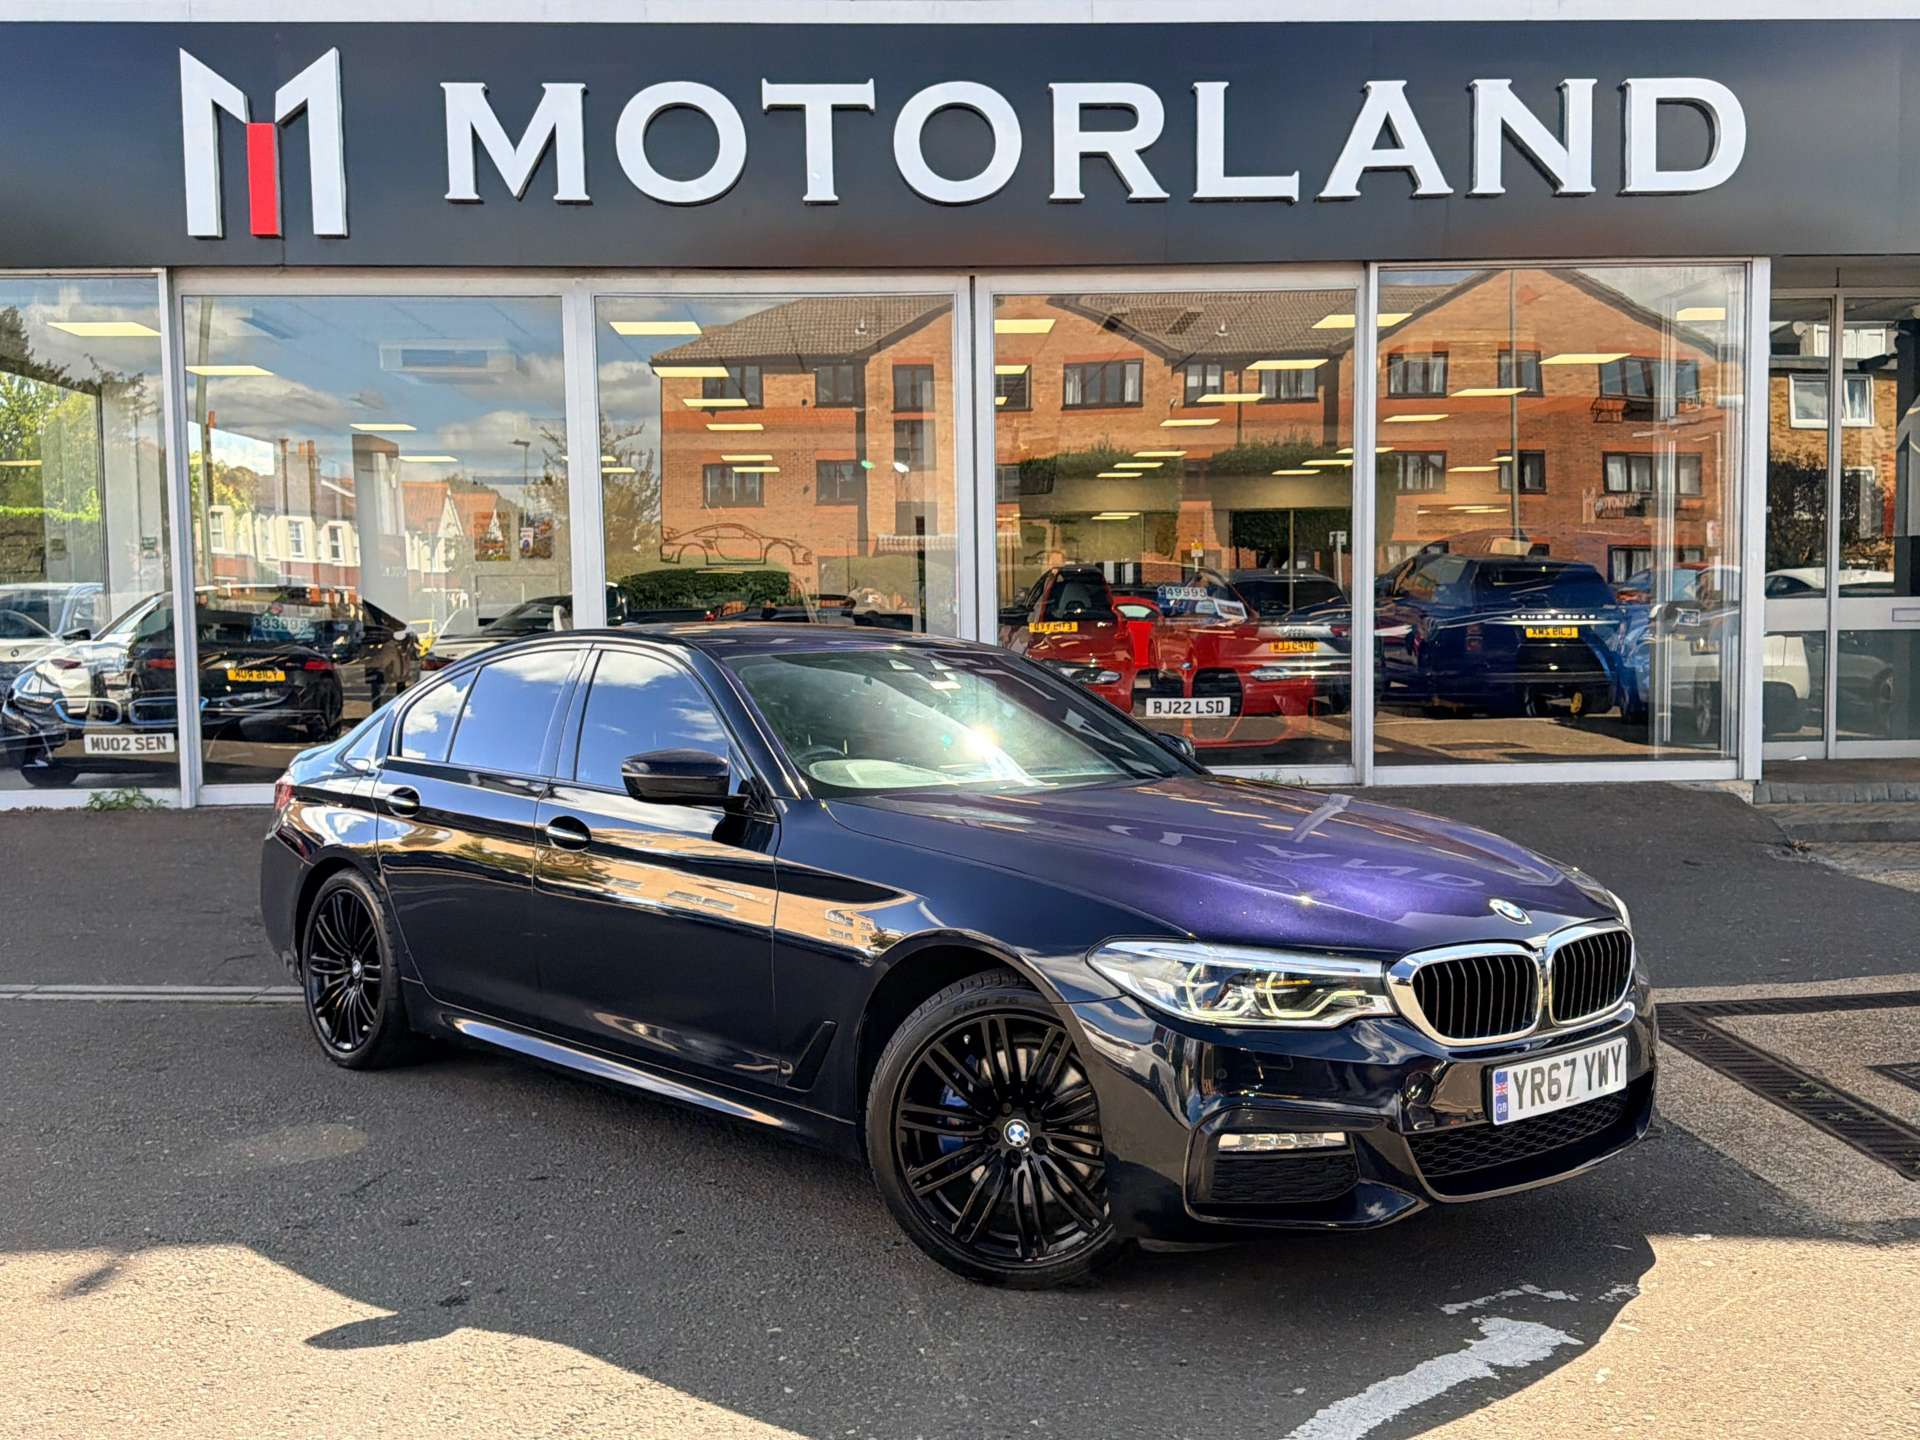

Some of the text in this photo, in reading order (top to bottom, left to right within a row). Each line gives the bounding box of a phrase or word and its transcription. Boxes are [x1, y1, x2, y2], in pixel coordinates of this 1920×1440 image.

[440, 77, 1747, 204] MOTORLAND
[1153, 700, 1224, 714] BJ22 LSD
[90, 736, 167, 751] MU02 SEN
[1513, 1045, 1622, 1109] YR67 YWY
[1496, 1102, 1507, 1114] GB
